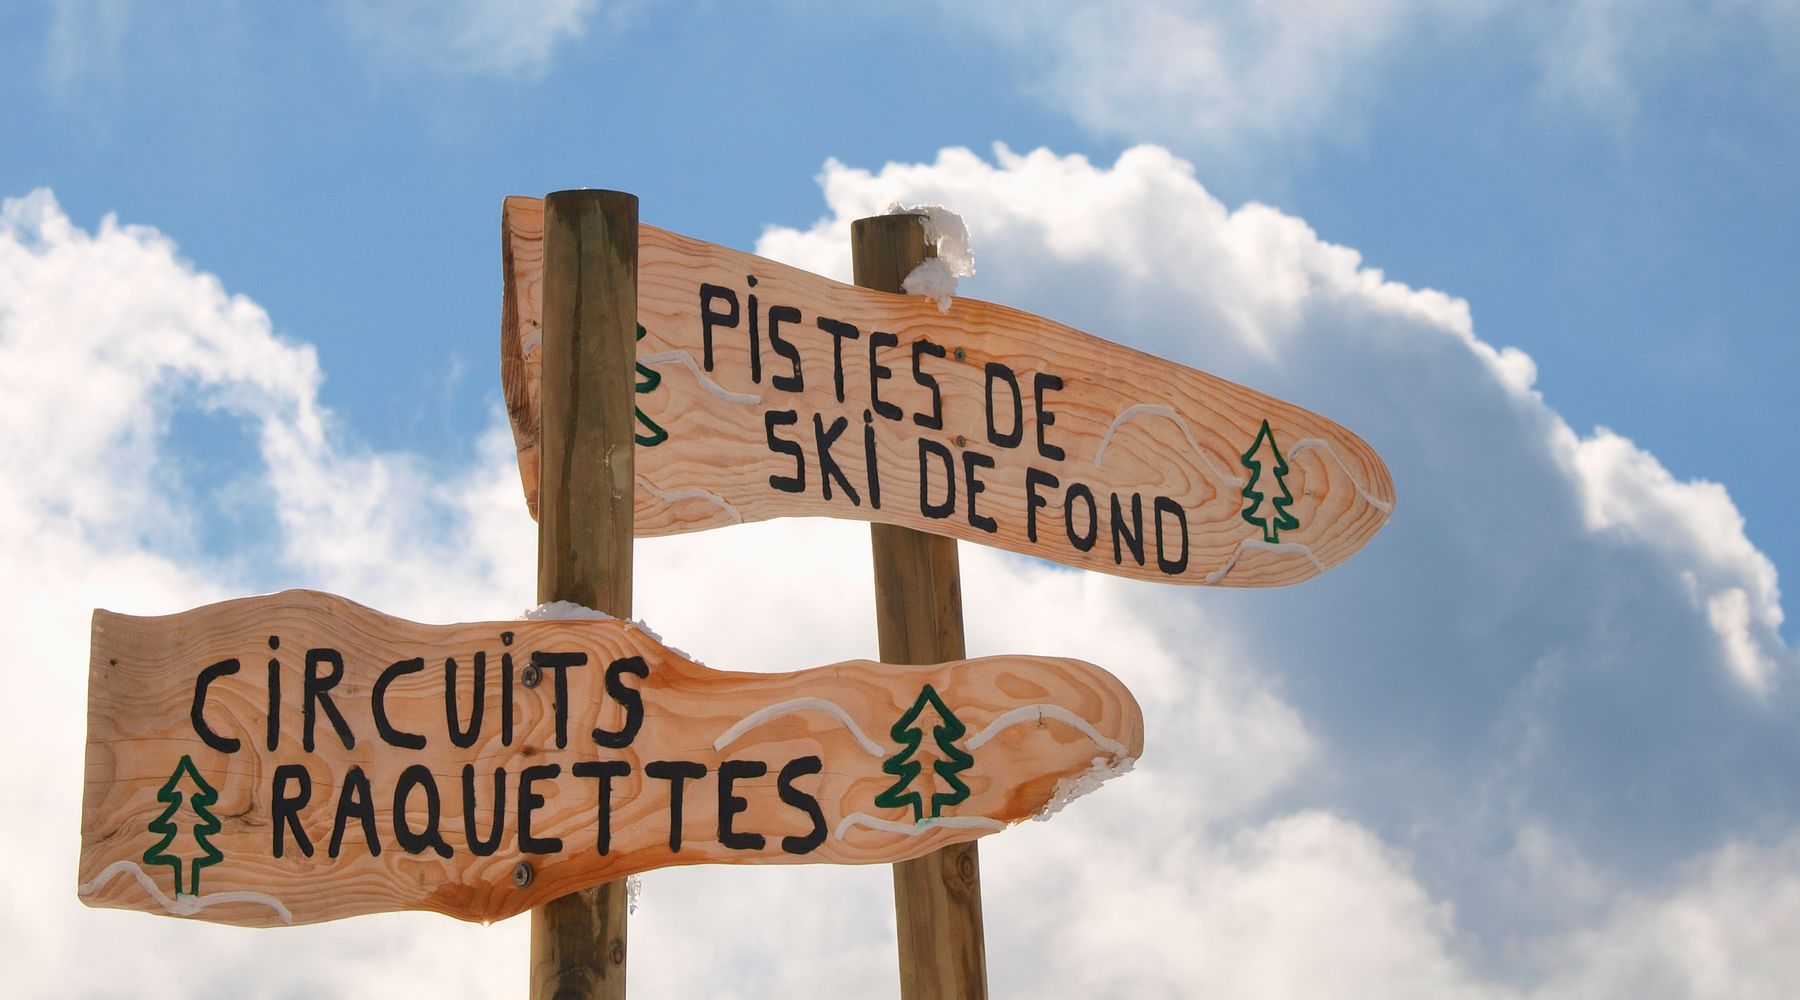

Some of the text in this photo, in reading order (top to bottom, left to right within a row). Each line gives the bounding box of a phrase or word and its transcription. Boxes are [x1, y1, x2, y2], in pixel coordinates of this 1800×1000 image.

[984, 362, 1067, 462] DE
[918, 437, 999, 534] DE
[1025, 467, 1190, 577] FOND
[271, 755, 829, 858] RAQUETTES
